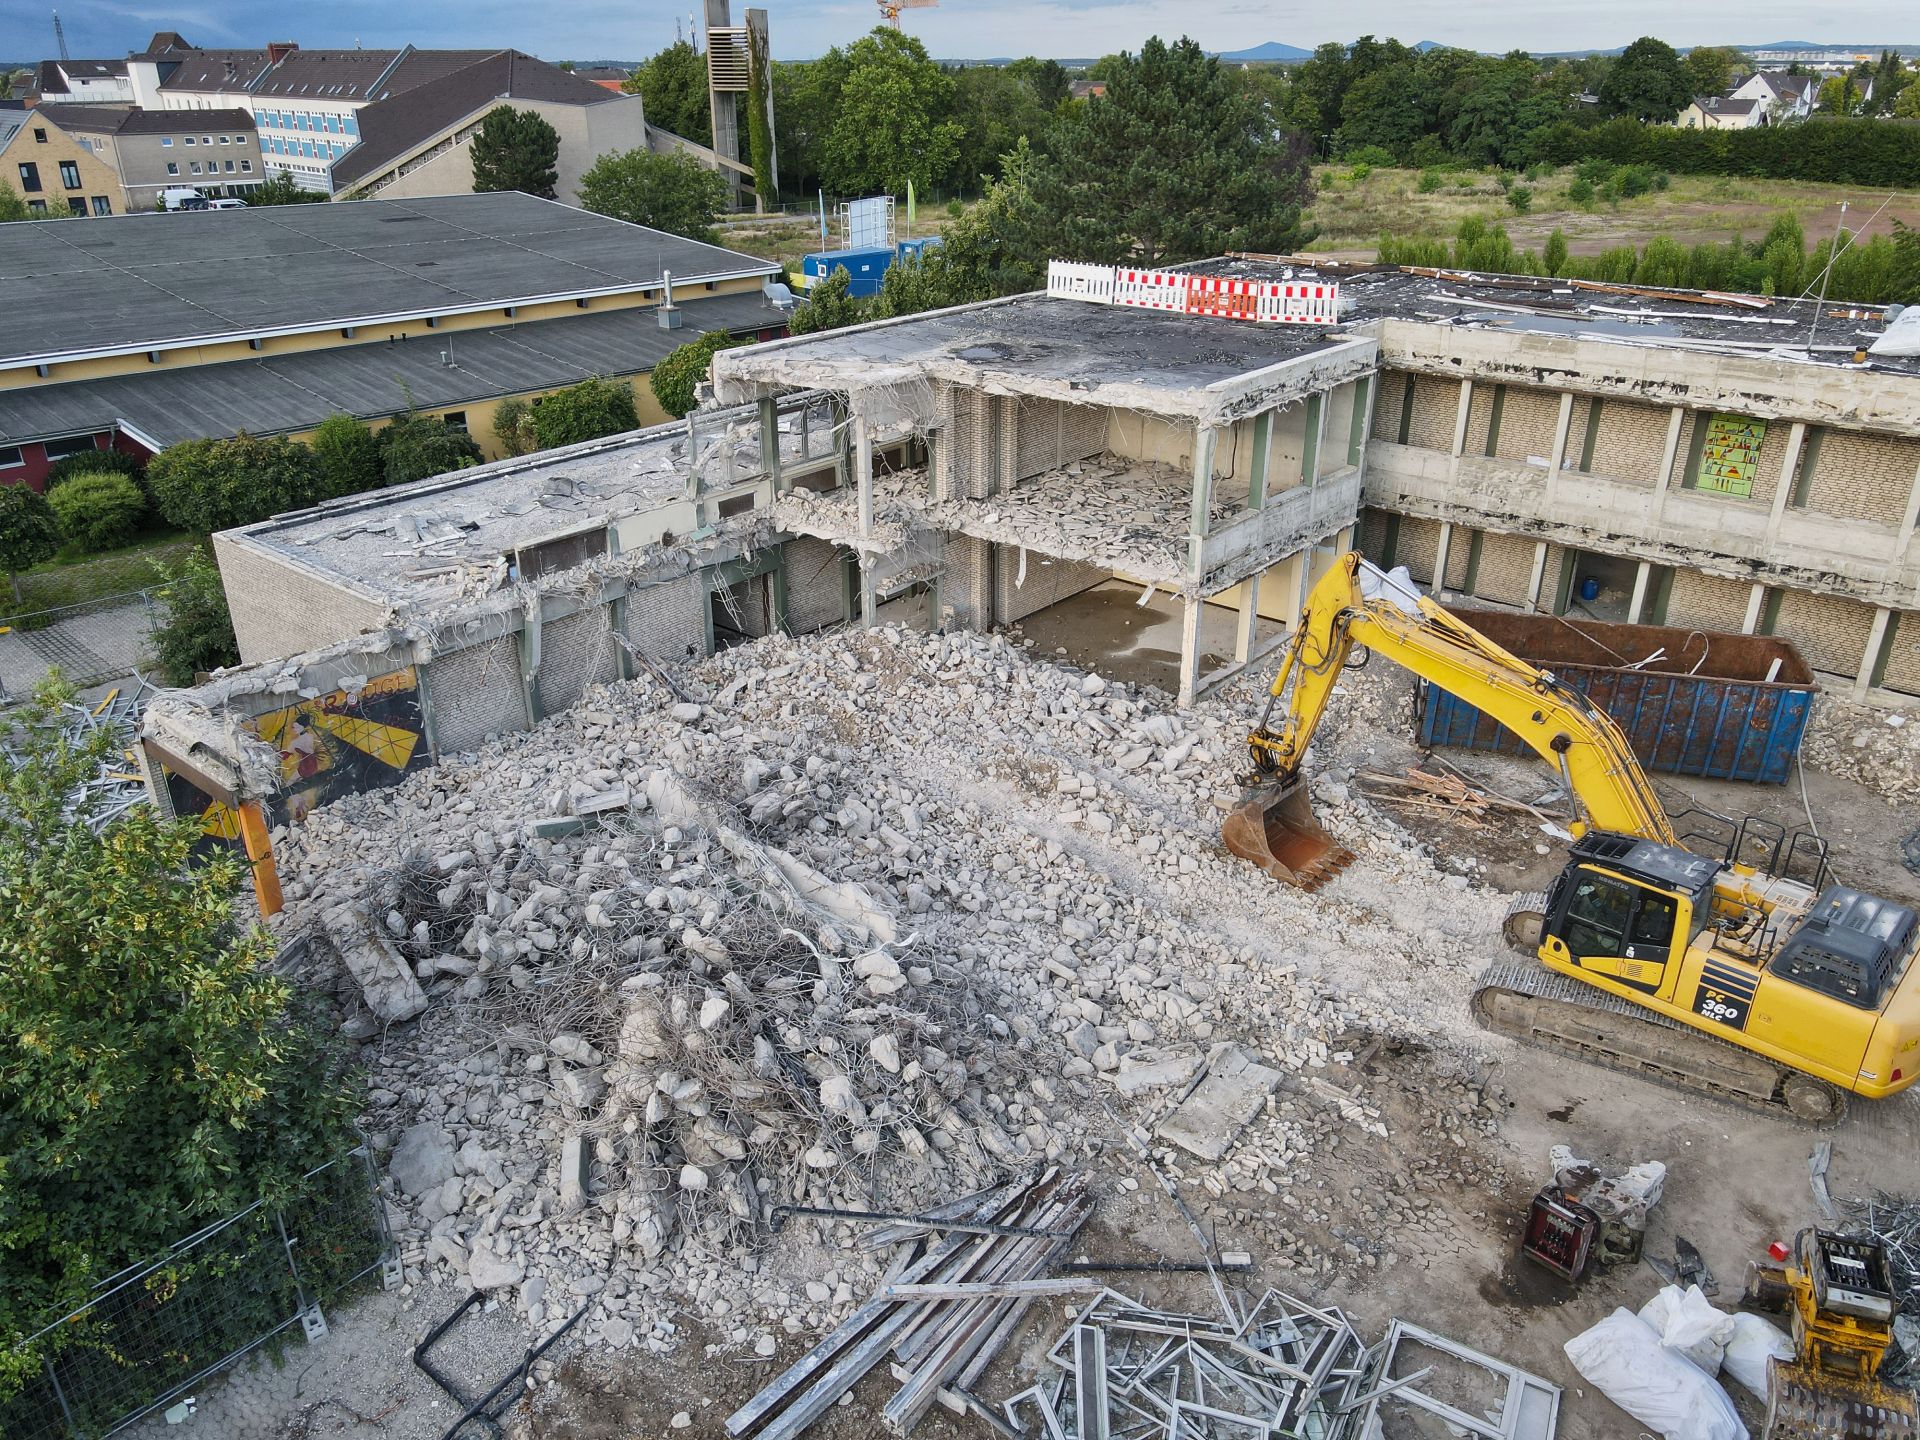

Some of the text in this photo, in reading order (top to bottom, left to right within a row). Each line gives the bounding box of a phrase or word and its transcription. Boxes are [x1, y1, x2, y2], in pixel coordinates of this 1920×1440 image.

[1599, 876, 1629, 890] KOMATSU
[1705, 990, 1725, 1003] PC
[1701, 1009, 1723, 1021] NLC
[1702, 999, 1738, 1019] 360
